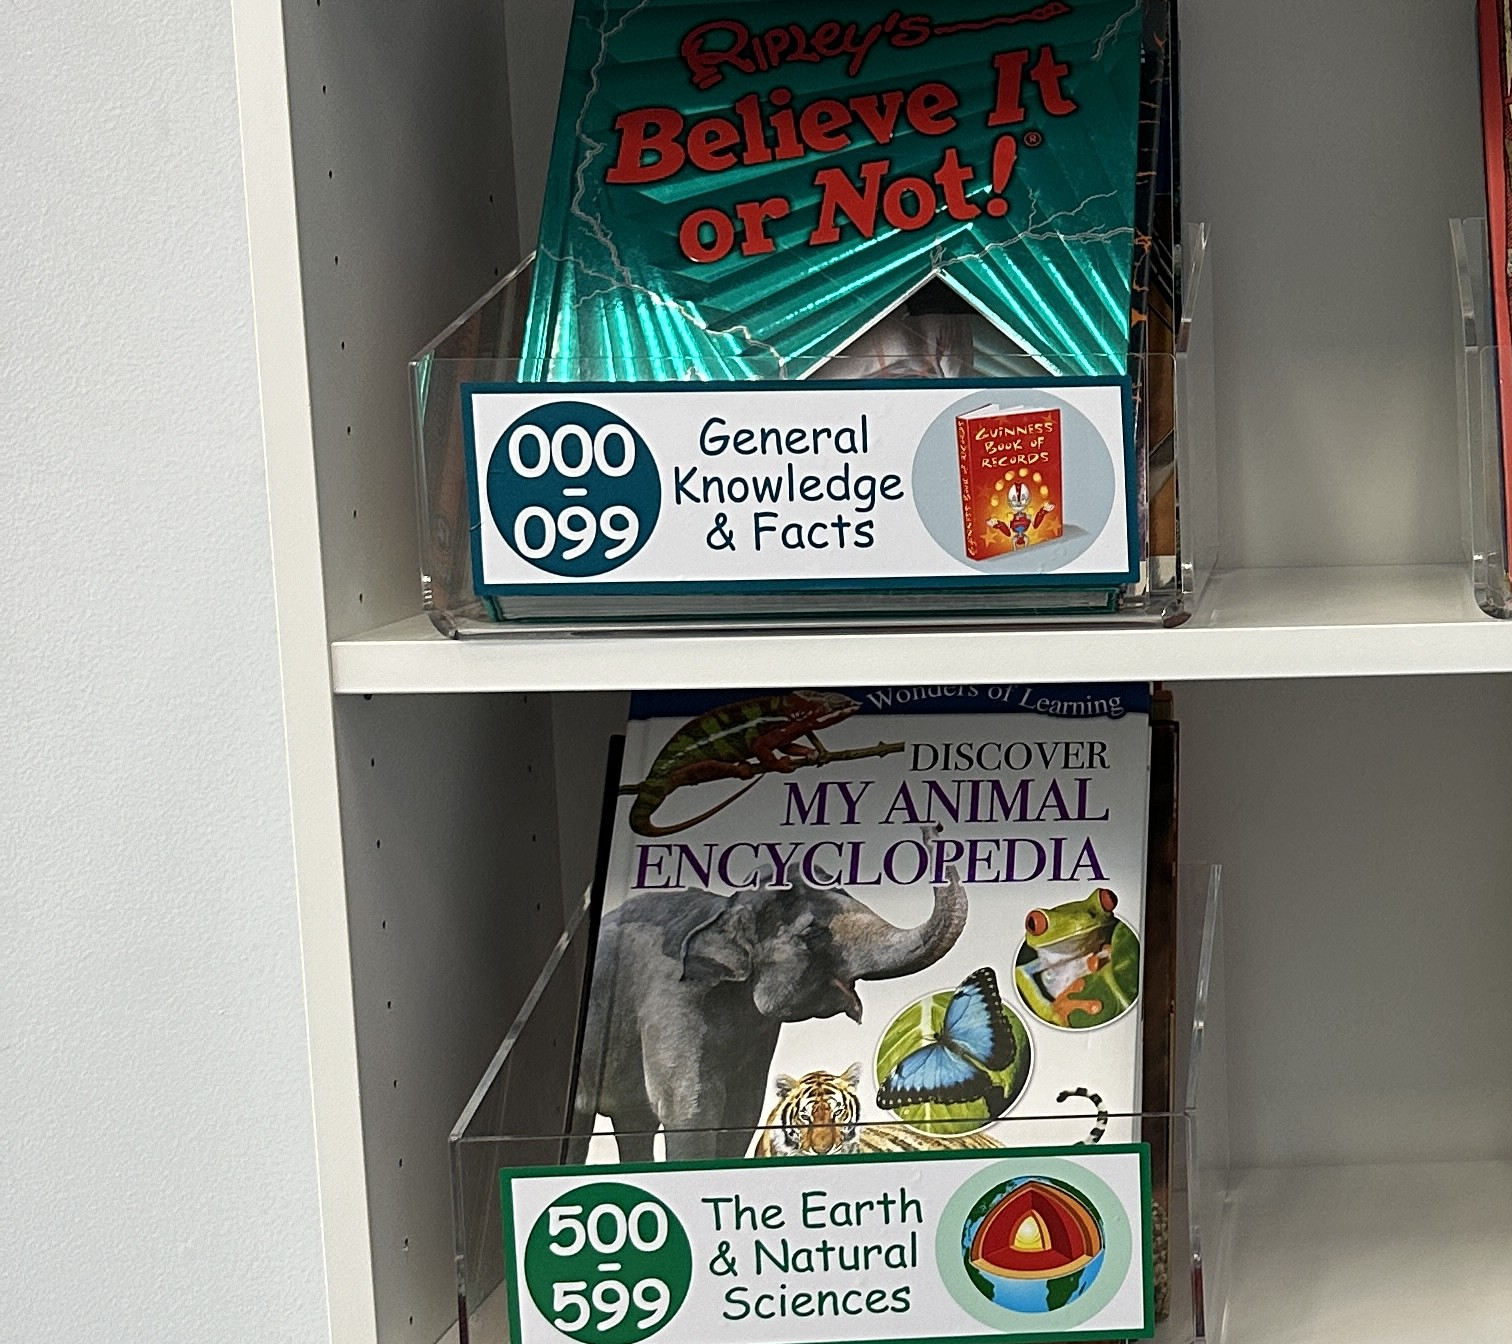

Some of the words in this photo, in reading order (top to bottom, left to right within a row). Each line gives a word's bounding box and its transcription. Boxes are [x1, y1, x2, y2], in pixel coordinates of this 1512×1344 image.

[605, 82, 959, 185] Believe
[987, 46, 1079, 127] It
[679, 197, 790, 263] or
[808, 134, 1017, 246] Not!
[508, 423, 636, 478] 000
[700, 414, 869, 456] General
[984, 439, 1023, 455] BOOK
[1030, 436, 1045, 449] OF
[981, 451, 1049, 468] RECORDS
[673, 462, 905, 513] Knowledge
[513, 504, 639, 561] 099
[705, 512, 736, 551] &
[753, 511, 875, 551] Facts
[866, 684, 979, 710] Wonders
[987, 684, 1018, 702] of
[1018, 687, 1124, 717] Learning
[910, 741, 1111, 771] DISCOVER
[780, 781, 876, 827] MY
[879, 777, 1111, 825] ANIMAL
[629, 835, 1111, 890] ENCYCLOPEDIA
[548, 1201, 668, 1256] 500
[701, 1194, 786, 1231] The
[801, 1187, 924, 1230] Earth
[709, 1240, 738, 1277] &
[755, 1231, 918, 1275] Natural
[551, 1277, 671, 1332] 599
[722, 1283, 912, 1321] Sciences
